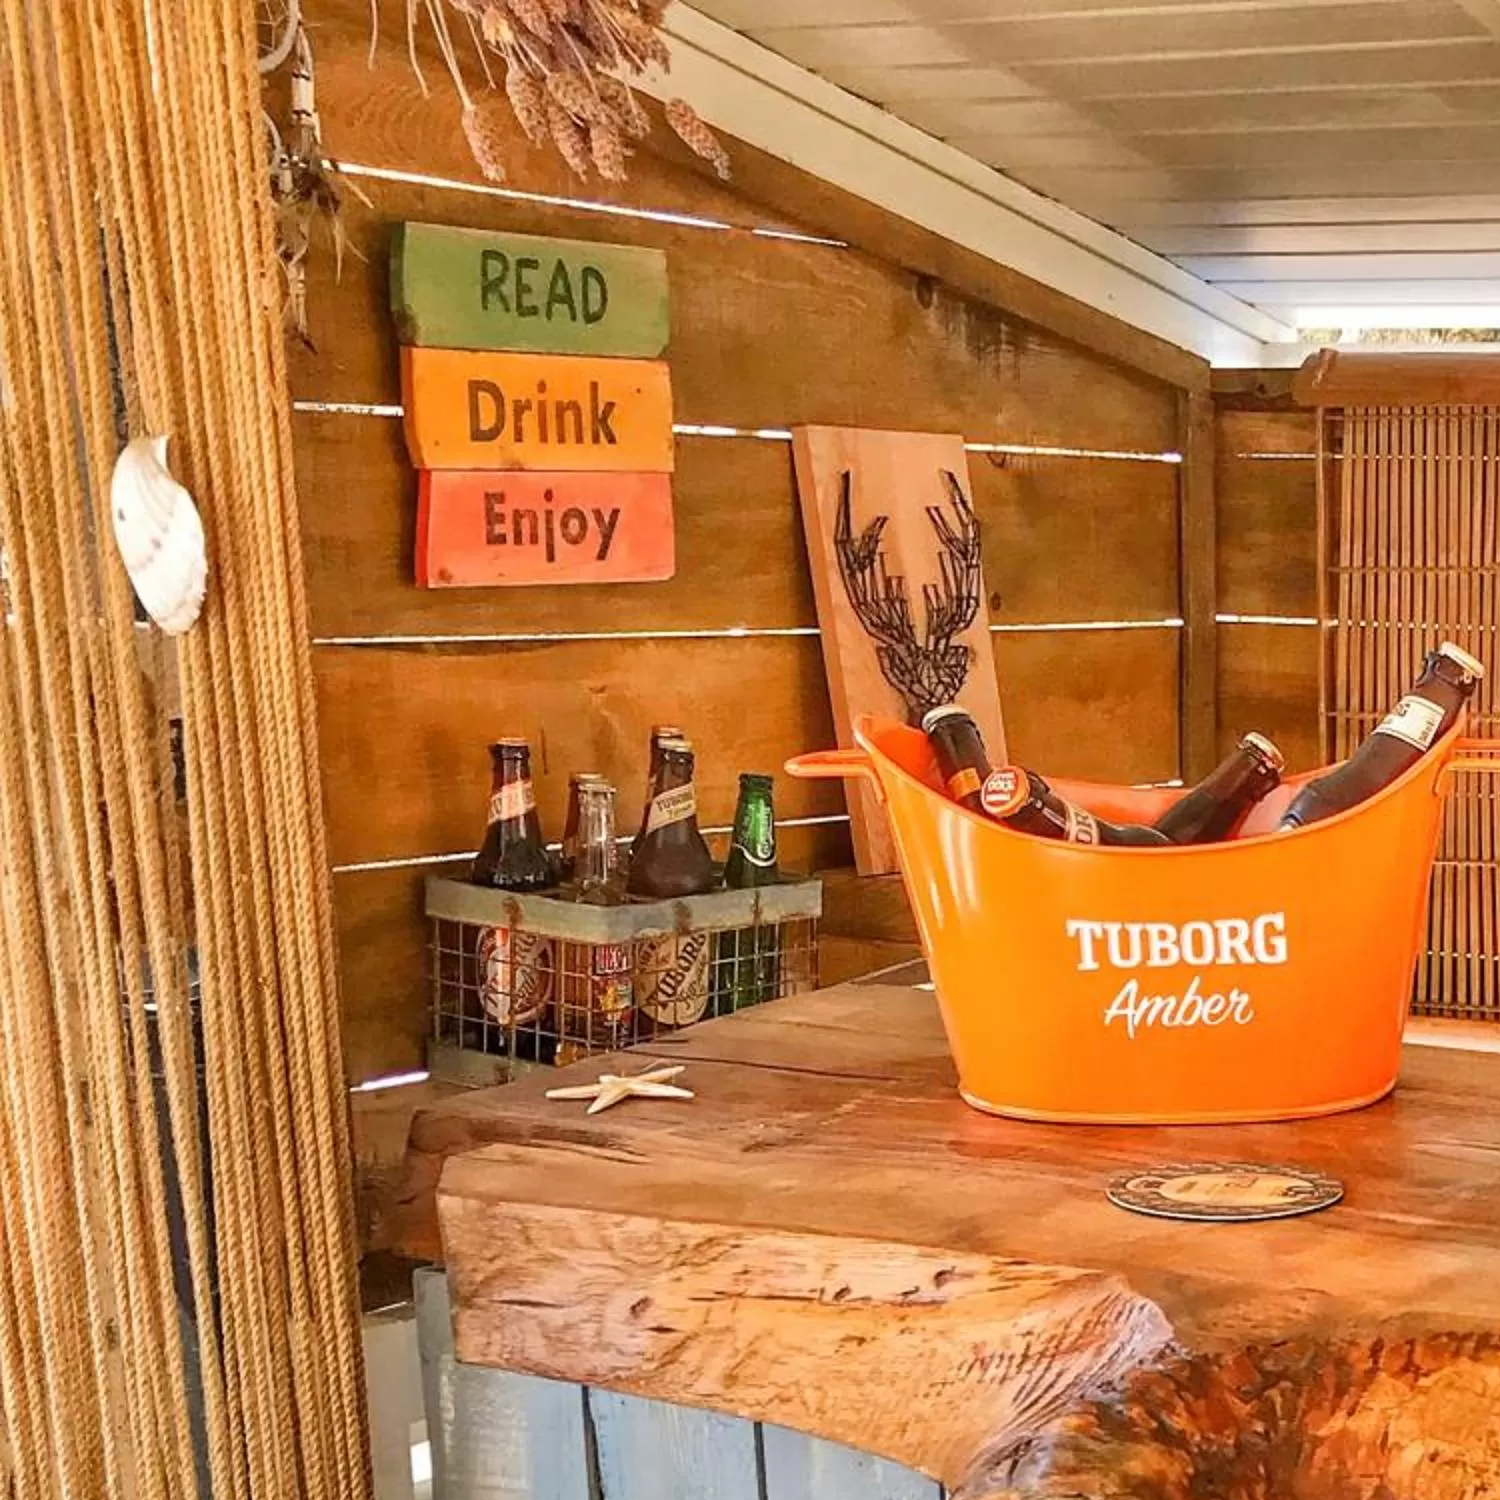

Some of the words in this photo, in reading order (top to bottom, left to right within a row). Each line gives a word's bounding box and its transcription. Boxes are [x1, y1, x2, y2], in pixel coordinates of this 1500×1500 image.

[480, 249, 608, 325] READ
[467, 379, 618, 445] Drink
[483, 488, 621, 563] Enjoy
[1066, 912, 1288, 971] TUBORG
[1104, 976, 1254, 1040] Amber
